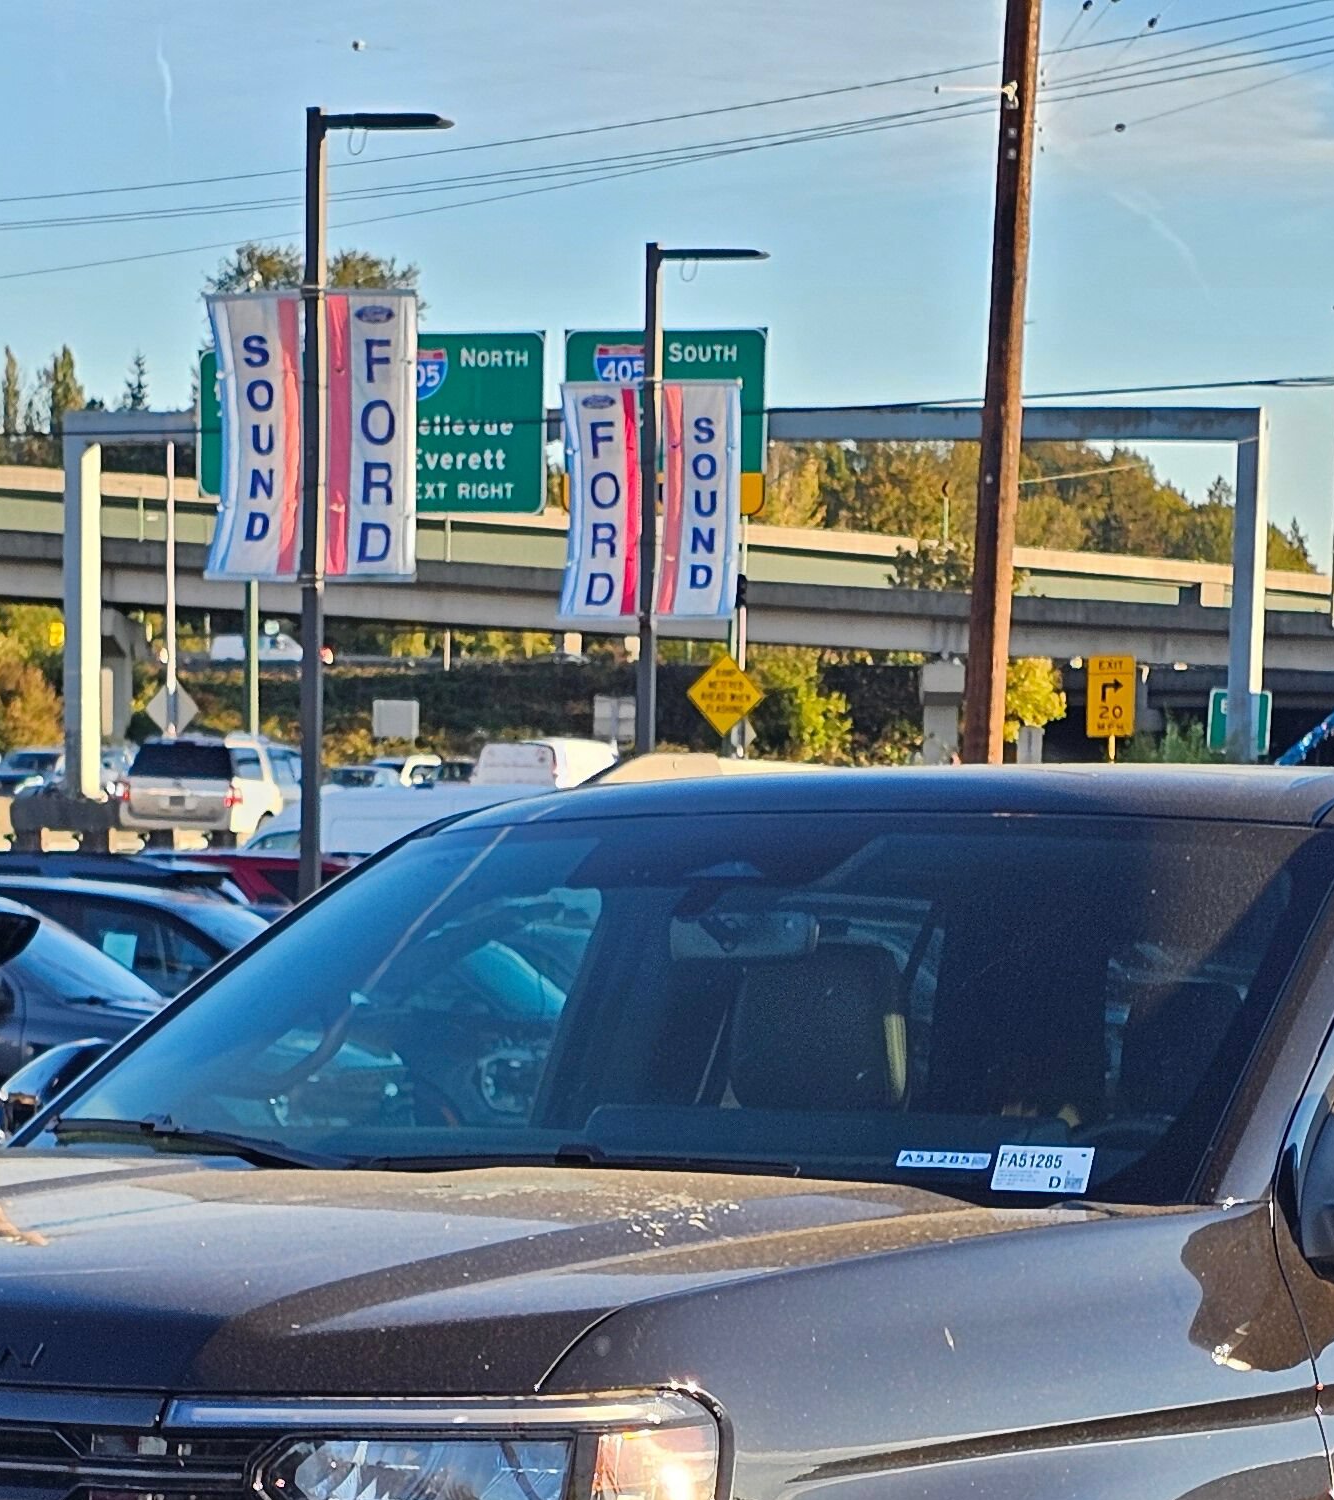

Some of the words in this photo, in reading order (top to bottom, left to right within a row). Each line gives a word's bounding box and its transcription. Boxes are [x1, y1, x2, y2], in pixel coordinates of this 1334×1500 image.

[418, 414, 514, 436] ellevue
[242, 334, 275, 542] SOUND
[356, 338, 396, 564] FORD
[457, 482, 515, 500] RIGHT
[584, 420, 621, 606] FORD
[689, 416, 718, 590] SOUND
[1098, 660, 1124, 671] EXIT
[1098, 705, 1124, 720] 20
[999, 1152, 1064, 1169] FA51285
[1048, 1176, 1062, 1189] D
